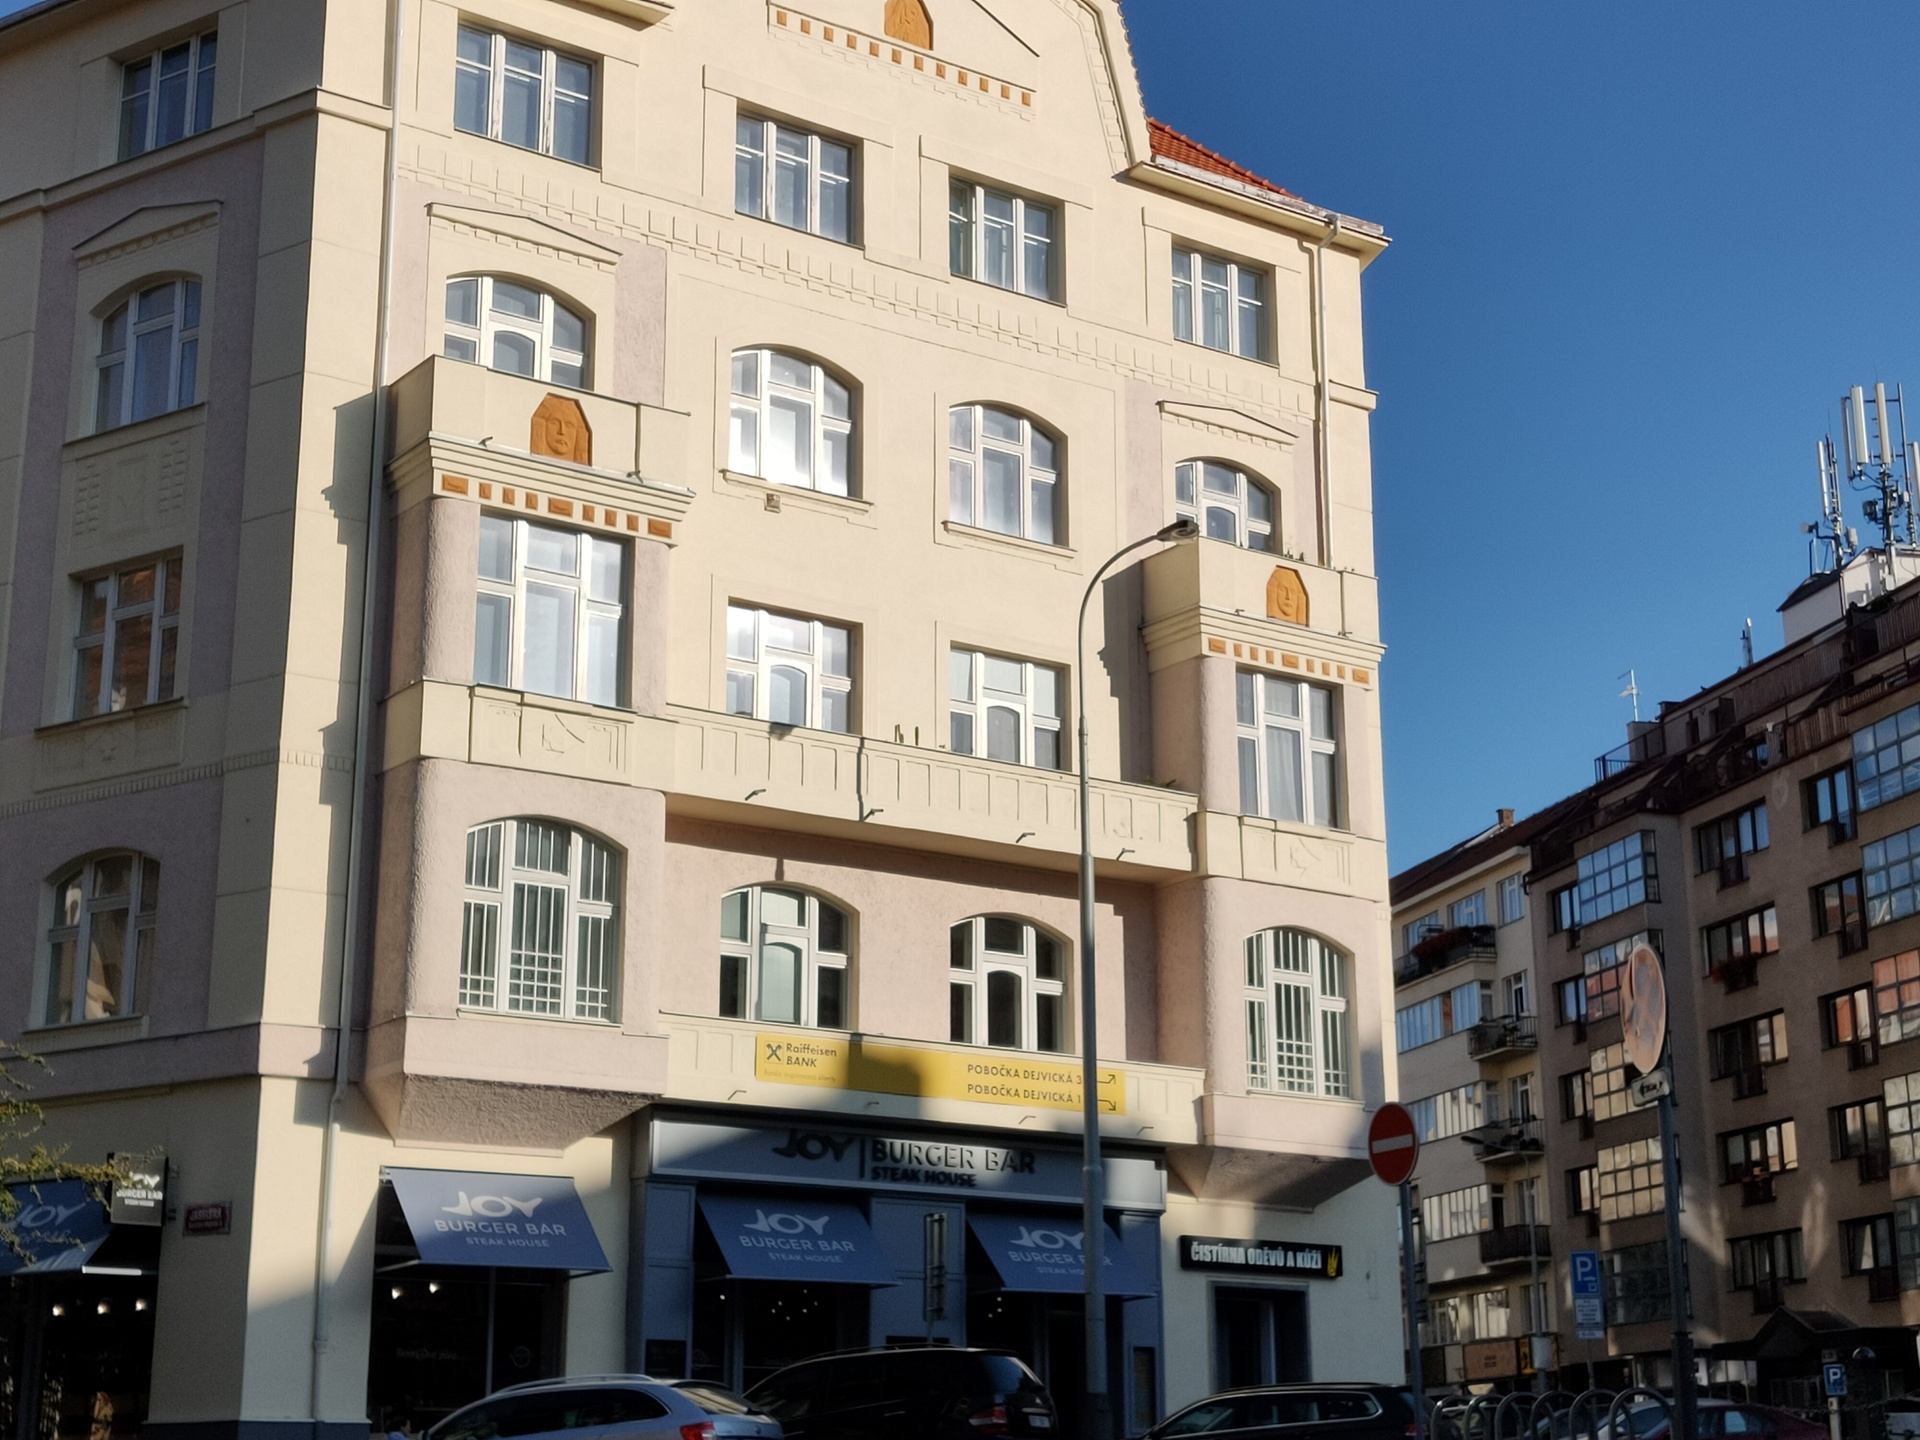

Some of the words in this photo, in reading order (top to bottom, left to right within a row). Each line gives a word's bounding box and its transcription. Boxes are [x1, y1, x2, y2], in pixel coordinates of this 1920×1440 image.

[786, 1043, 837, 1057] Raiffeisen
[786, 1056, 817, 1067] BANK
[967, 1063, 1020, 1078] POBOČKA
[1023, 1070, 1073, 1085] DEJVICKÁ
[967, 1083, 1020, 1098] POBOČKA
[1023, 1089, 1074, 1104] DEJVICKÁ
[772, 1128, 855, 1162] JOY
[871, 1138, 975, 1170] BURGER
[985, 1149, 1036, 1174] BAR
[871, 1166, 921, 1183] STEAK
[924, 1169, 977, 1187] HOUSE
[441, 1190, 543, 1218] JOY
[434, 1219, 520, 1235] BURGER
[525, 1223, 567, 1236] BAR
[743, 1209, 829, 1235] JOY
[466, 1236, 505, 1246] STEAK
[508, 1238, 550, 1248] HOUSE
[738, 1235, 815, 1251] BURGER
[818, 1240, 856, 1252] BAR
[1010, 1225, 1085, 1250] JOY
[768, 1252, 803, 1262] STEAK
[805, 1254, 842, 1263] HOUSE
[1008, 1251, 1076, 1264] BURGER
[1191, 1242, 1246, 1264] ČISTÍRNA
[1247, 1246, 1285, 1267] ODĚVŮ
[1286, 1251, 1295, 1268] A
[1575, 1256, 1592, 1281] P
[1829, 1368, 1841, 1383] P
